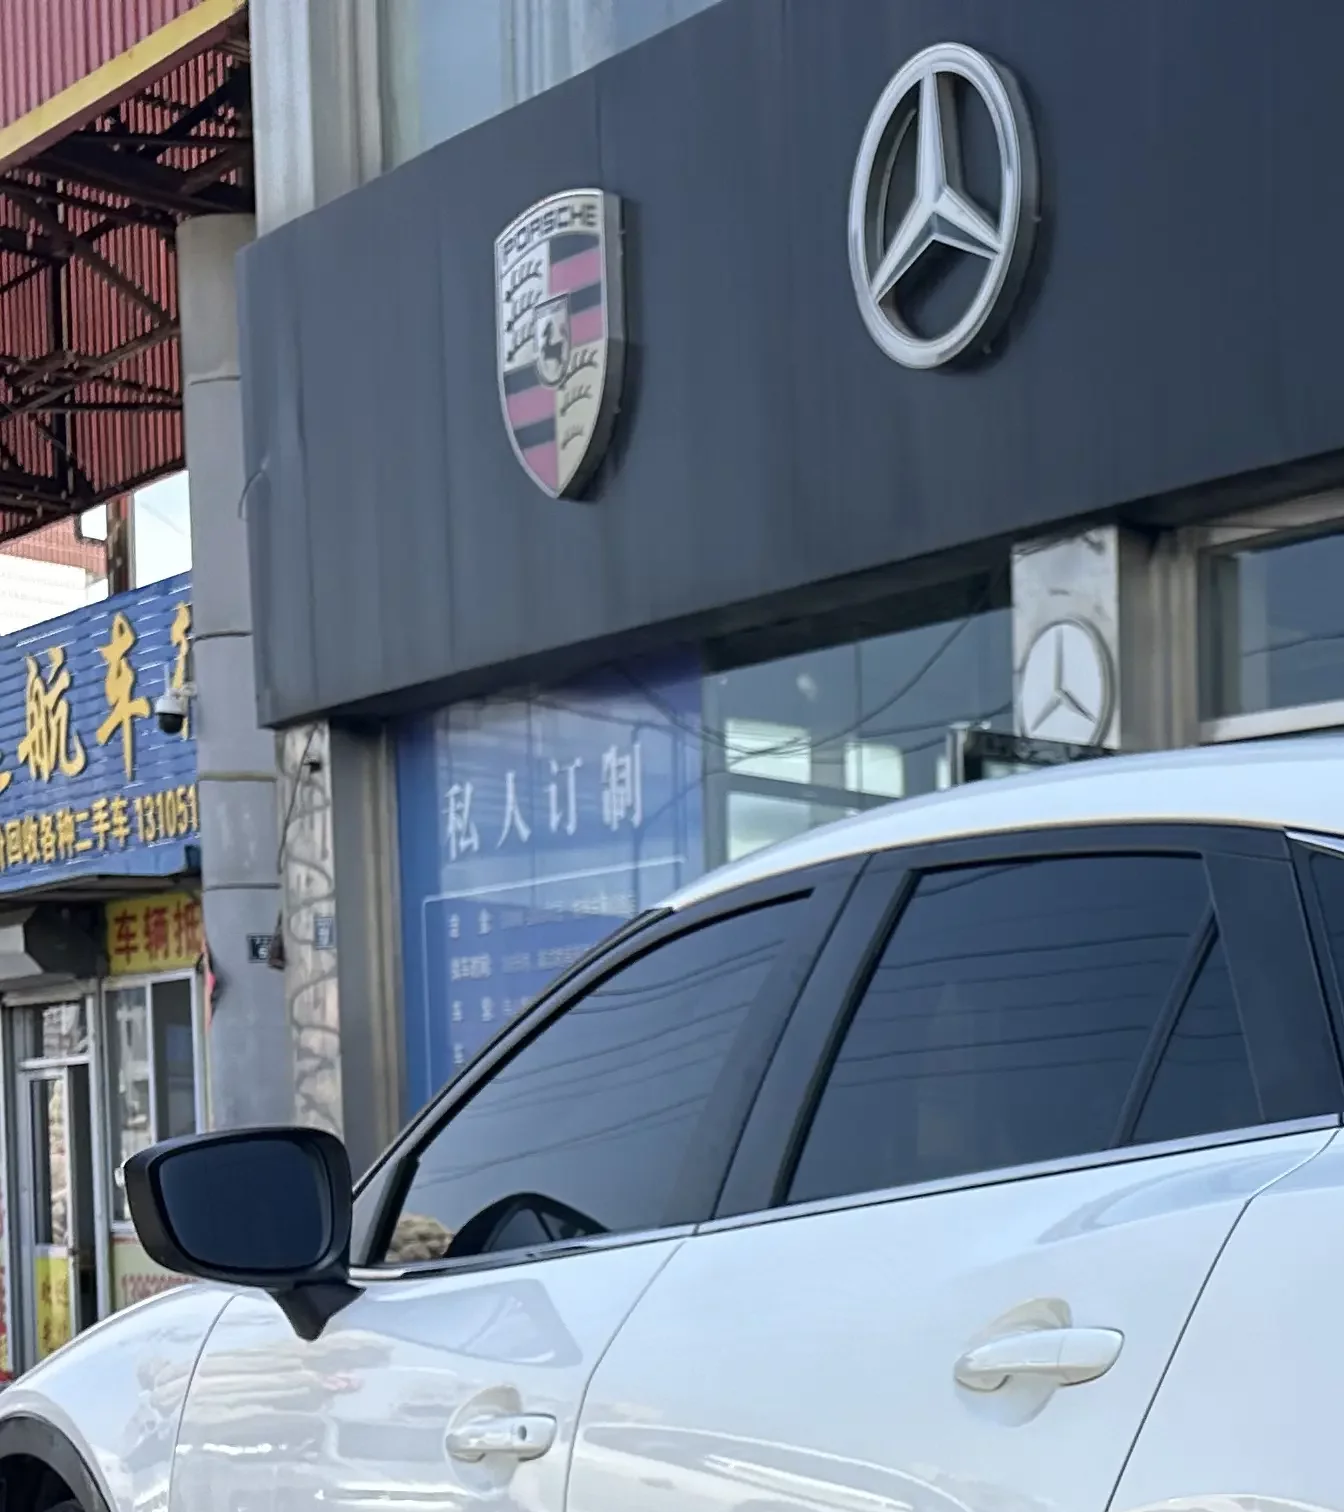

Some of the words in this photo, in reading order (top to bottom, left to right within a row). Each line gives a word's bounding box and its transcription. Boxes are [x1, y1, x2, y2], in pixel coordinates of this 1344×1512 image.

[503, 204, 597, 263] PORSCHE
[0, 602, 192, 796] 航车
[0, 793, 130, 874] 回收各种二手车
[441, 743, 643, 861] 私人订制
